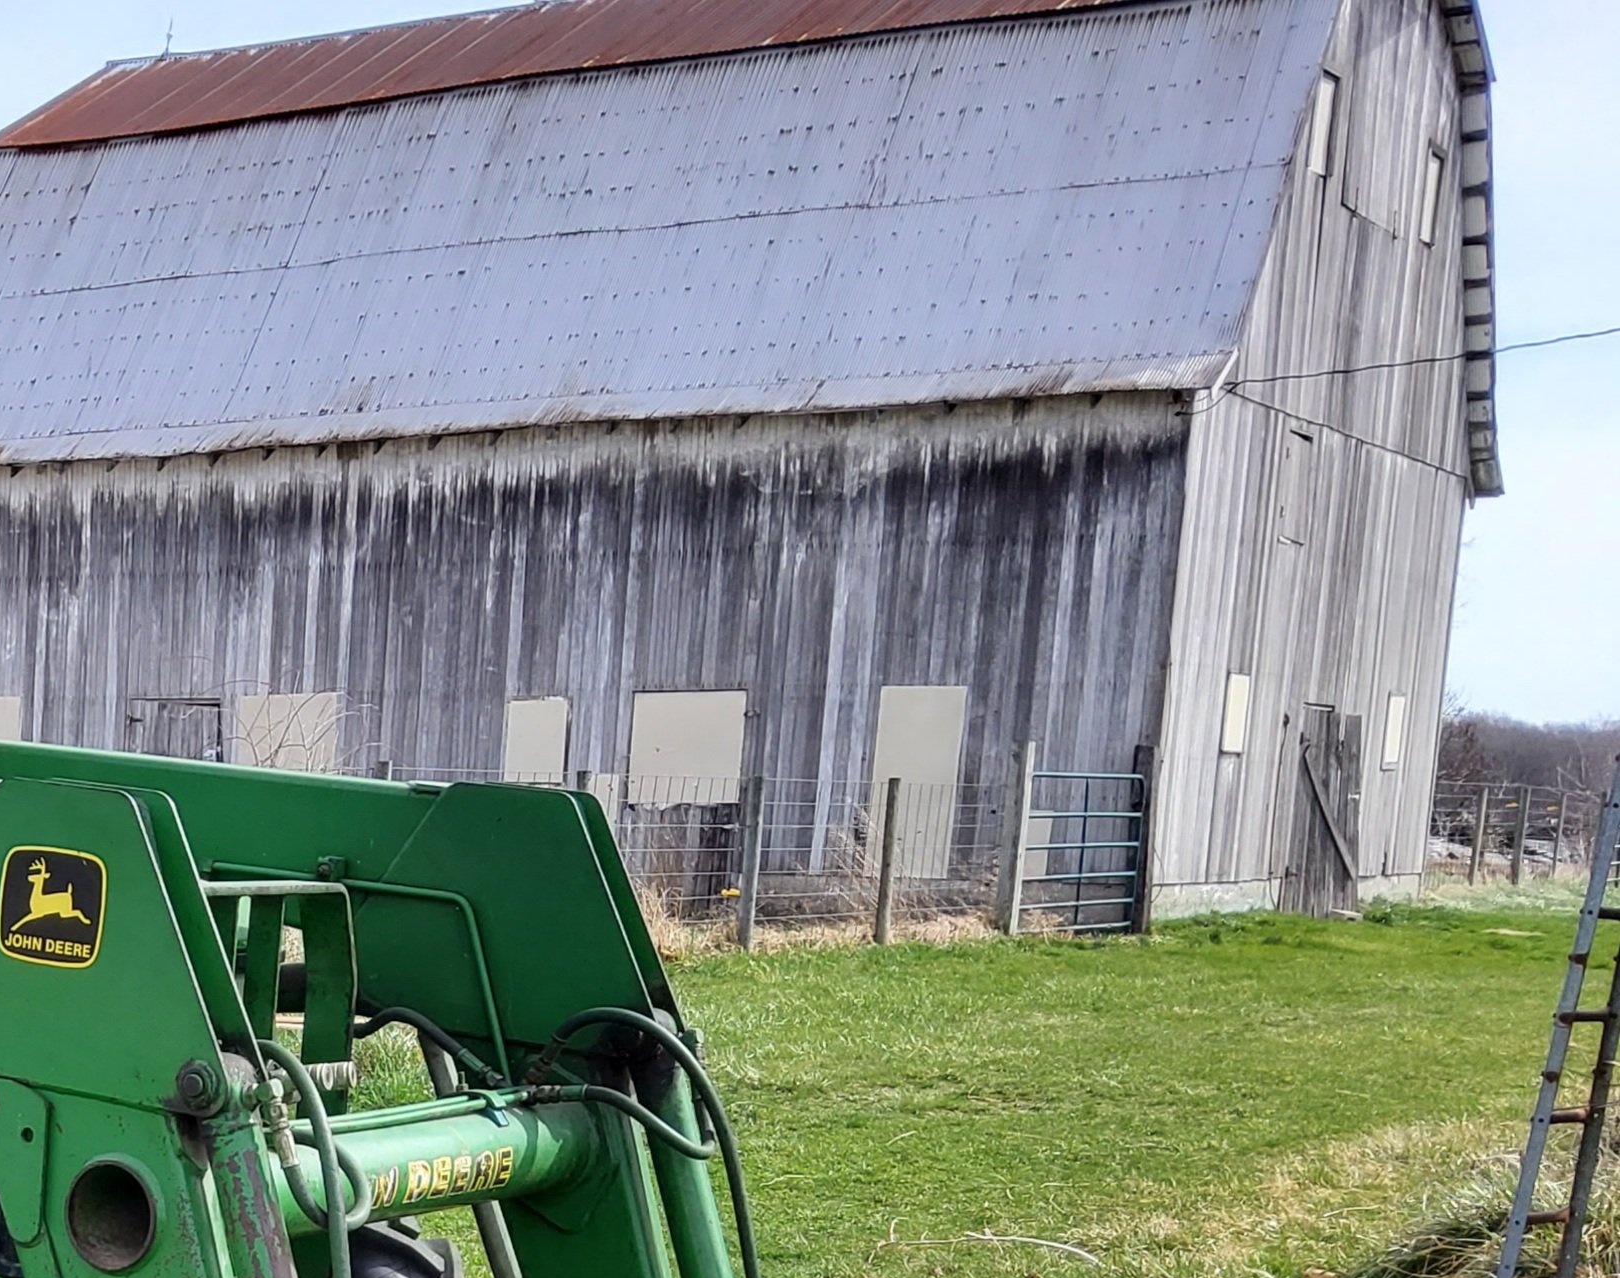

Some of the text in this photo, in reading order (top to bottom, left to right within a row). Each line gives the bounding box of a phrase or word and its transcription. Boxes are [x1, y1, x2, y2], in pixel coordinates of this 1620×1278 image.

[4, 932, 92, 958] JOHN DEERE
[401, 1146, 514, 1205] DEERE
